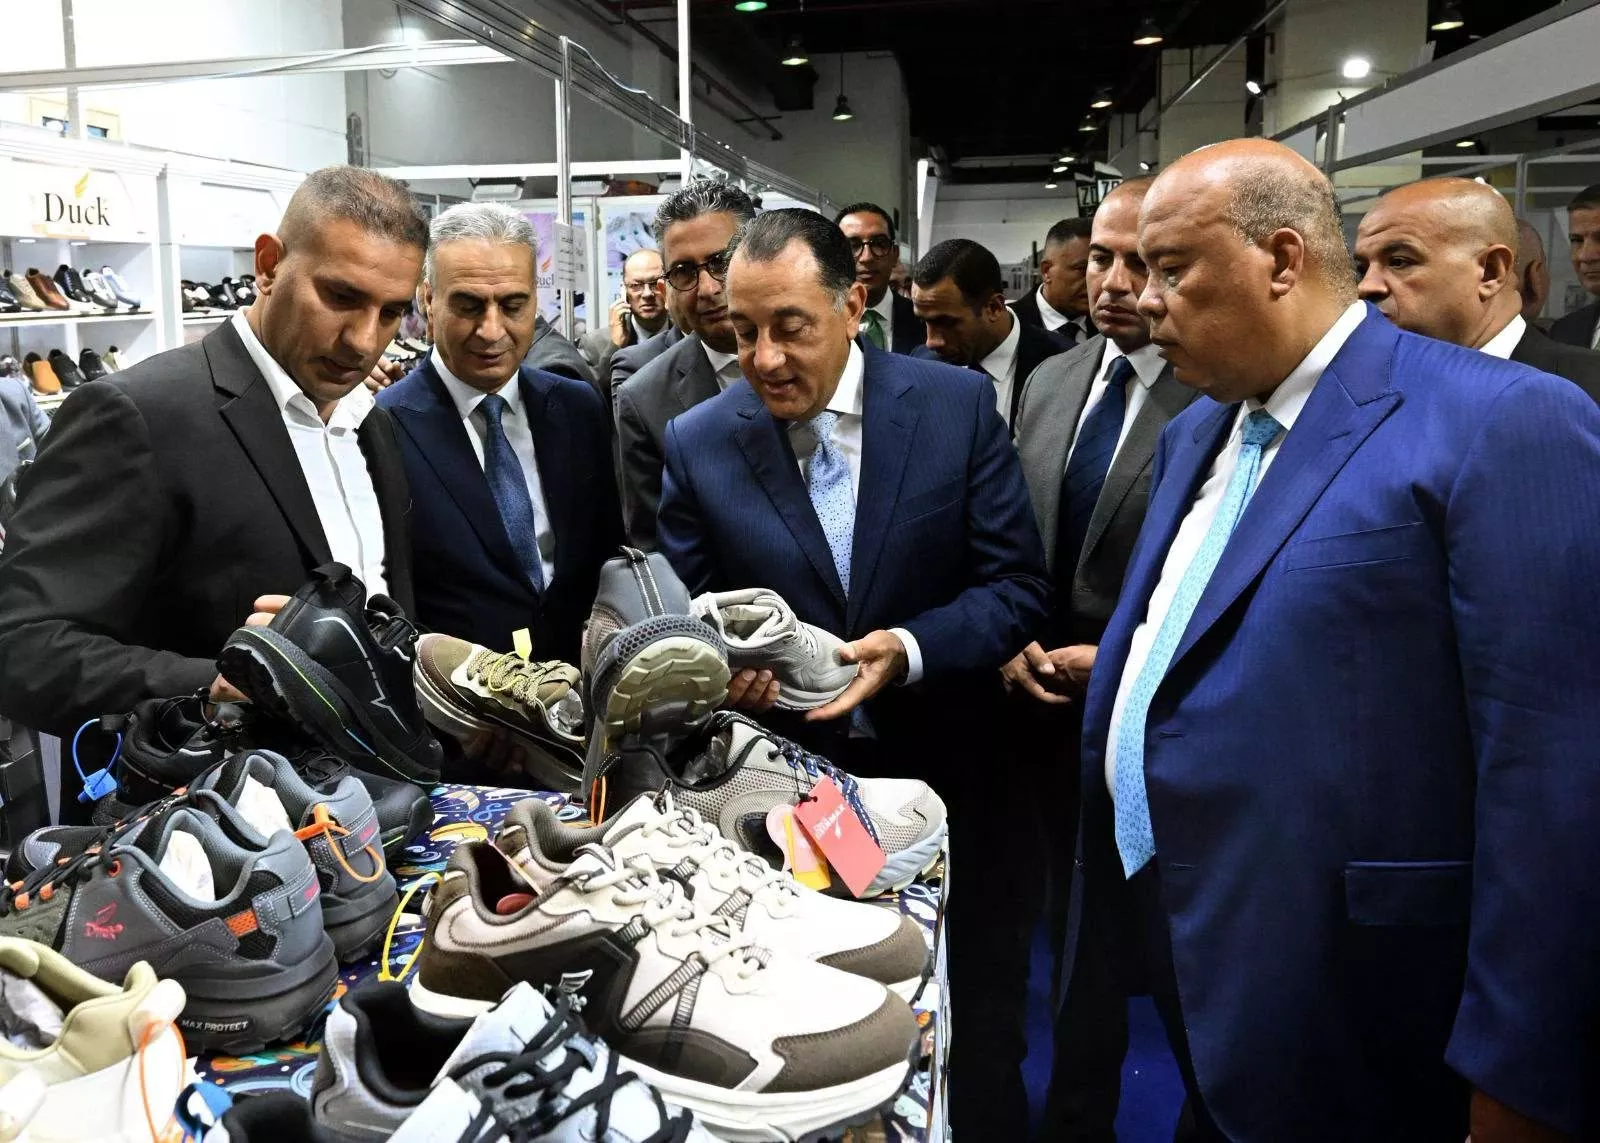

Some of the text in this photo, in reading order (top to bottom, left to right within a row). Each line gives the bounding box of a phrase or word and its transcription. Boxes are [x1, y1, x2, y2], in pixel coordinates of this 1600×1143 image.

[44, 192, 111, 227] Duck
[181, 1019, 249, 1033] MAX PROTECT
